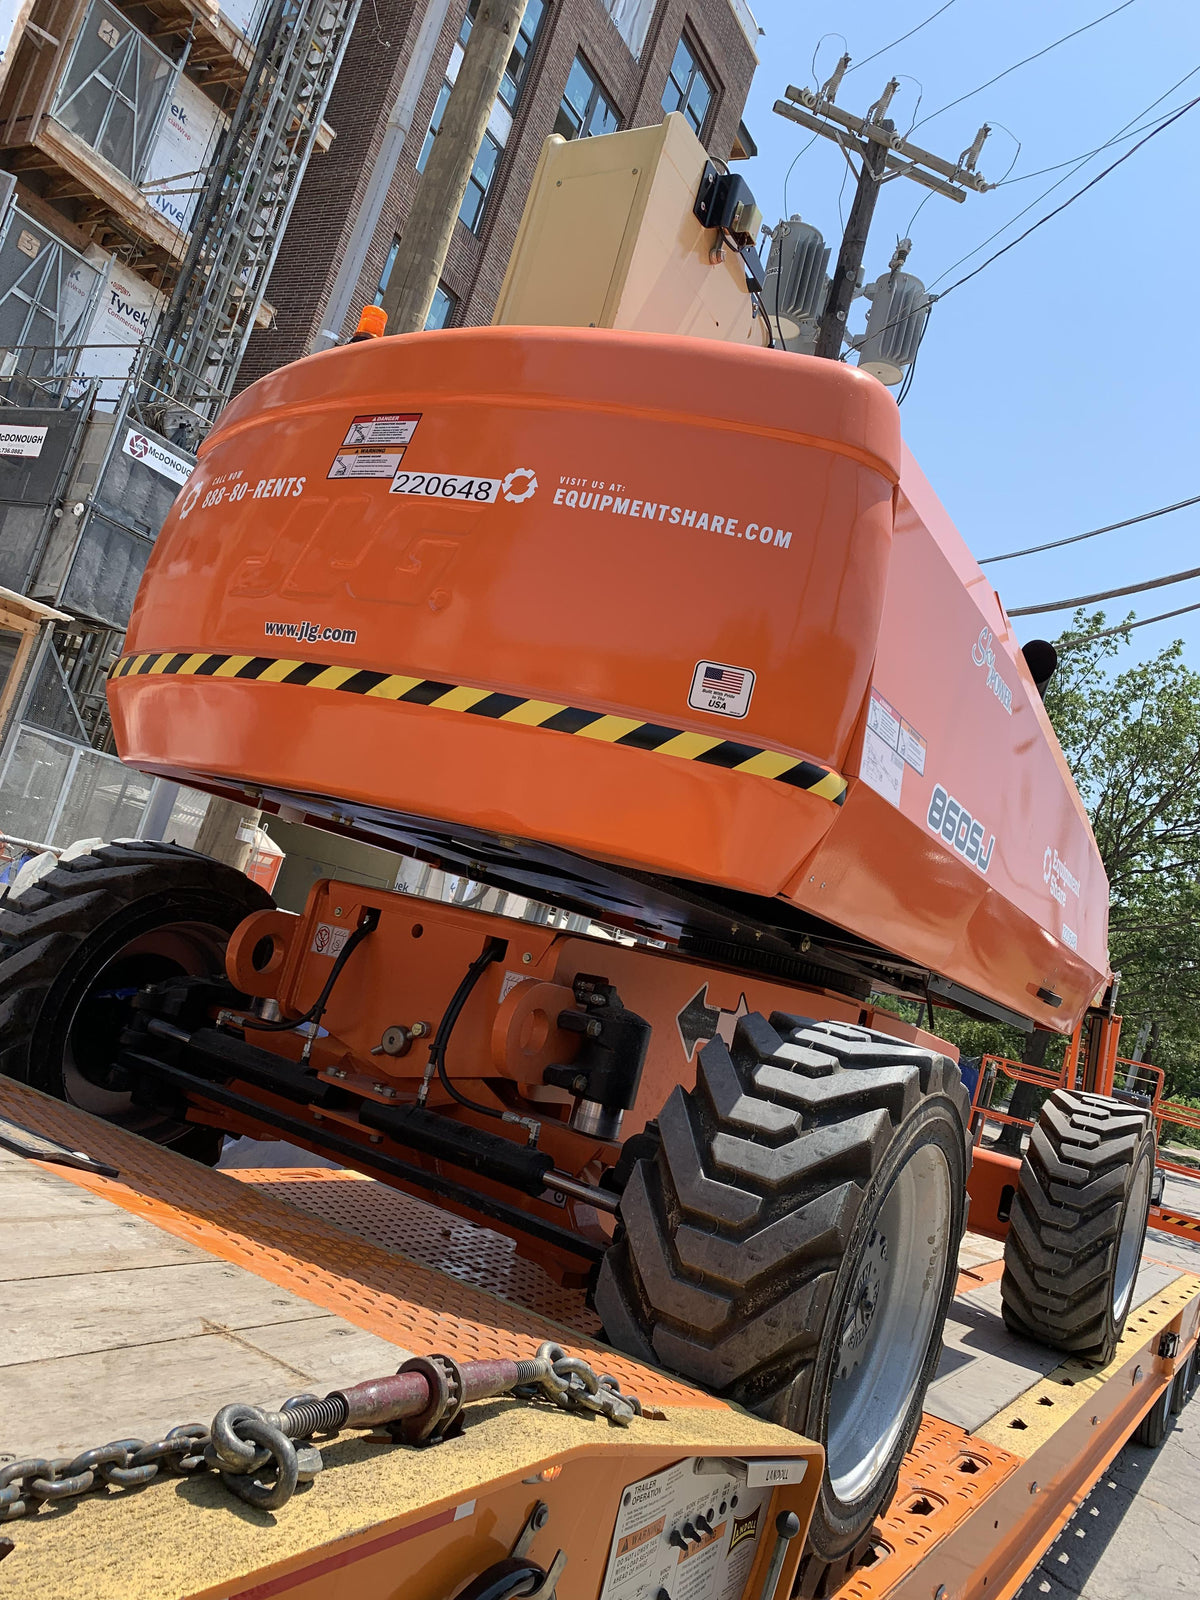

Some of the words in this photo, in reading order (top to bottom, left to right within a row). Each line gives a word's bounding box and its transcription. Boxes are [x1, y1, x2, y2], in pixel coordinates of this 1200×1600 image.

[110, 290, 149, 328] Tyvek
[0, 433, 43, 444] cDONOUGH
[212, 474, 227, 486] CALL
[228, 470, 243, 480] NOW
[392, 474, 492, 501] 220648
[559, 476, 587, 487] VISIT
[591, 480, 605, 489] US
[609, 483, 626, 492] AT:
[202, 477, 306, 508] 888-80-RENTS
[553, 488, 793, 549] EQUIPMENTSHARE.COM
[264, 620, 357, 644] www.jlg.com
[708, 699, 727, 710] USA
[632, 1487, 662, 1505] OPERATION
[634, 1480, 656, 1494] TRAILER
[632, 1520, 662, 1545] WARNING
[731, 1520, 757, 1548] LANDOLL
